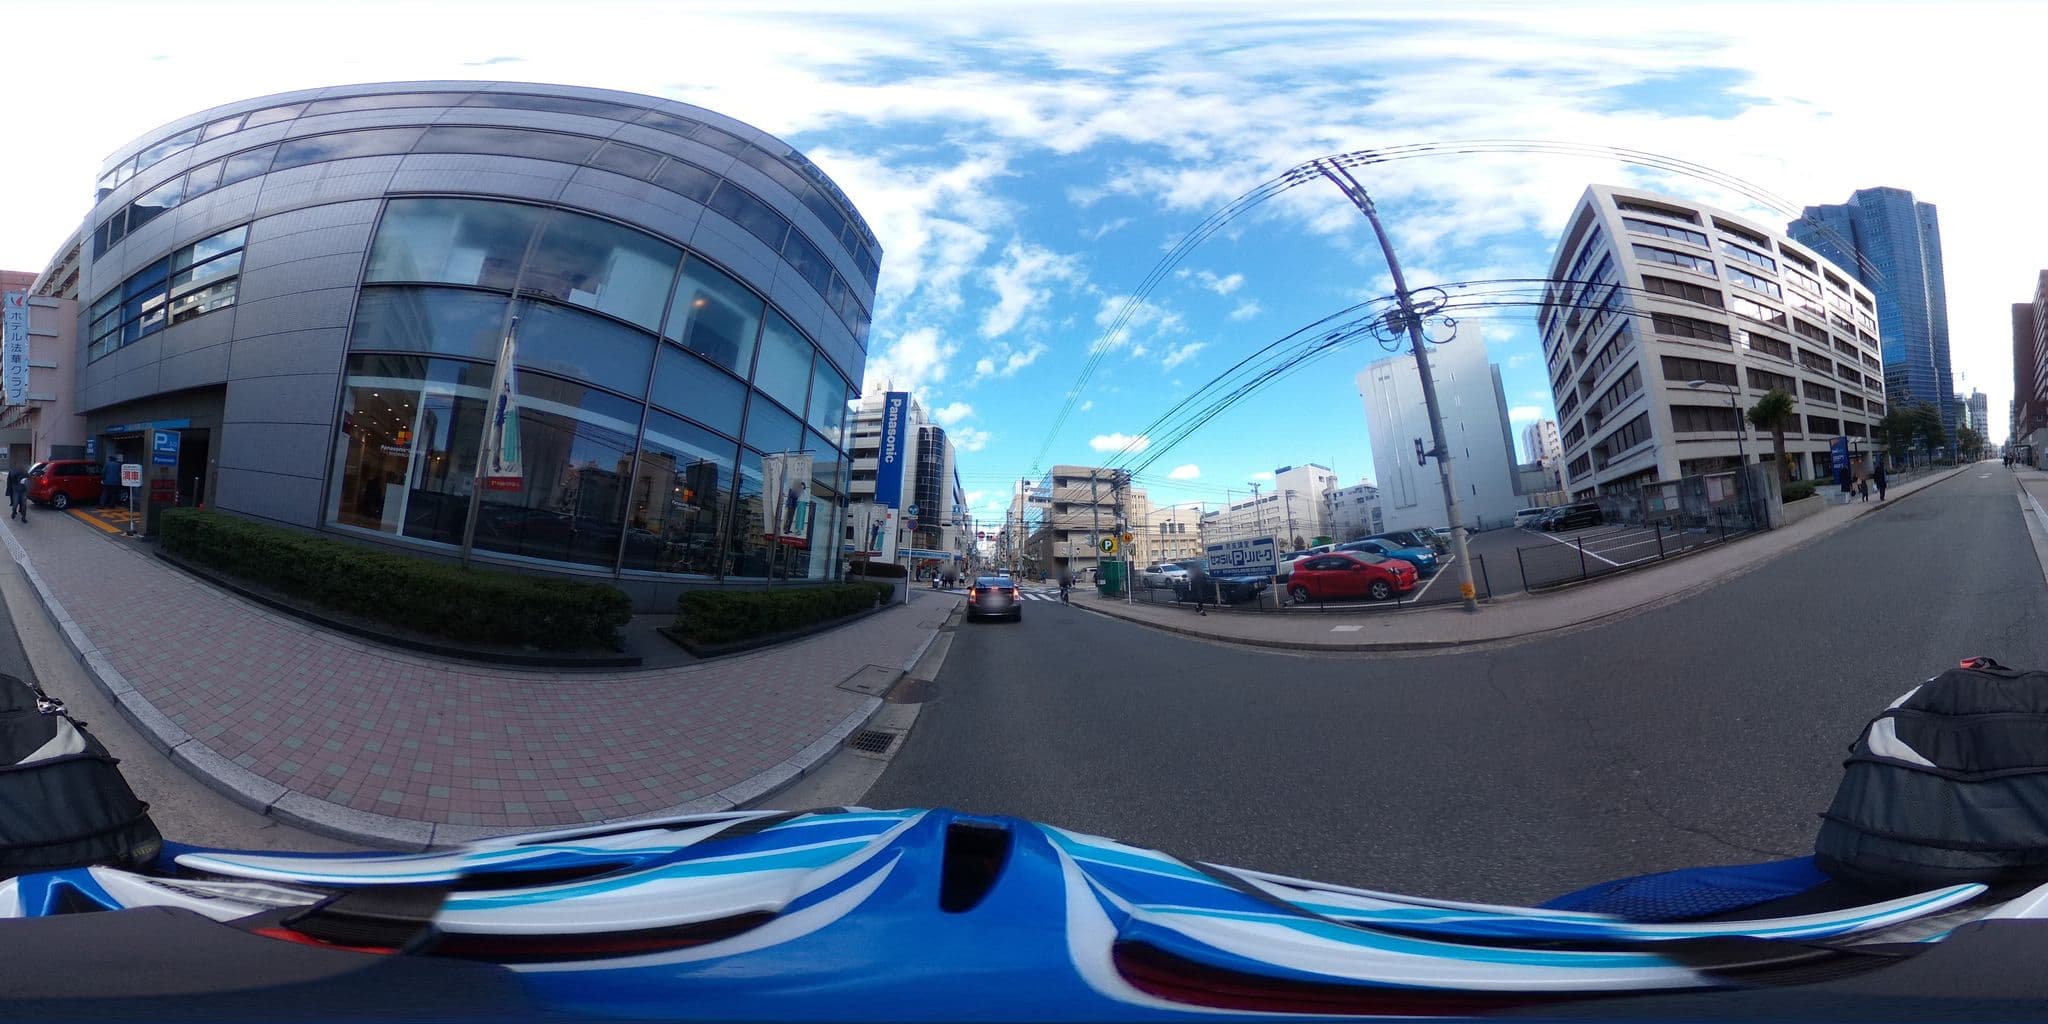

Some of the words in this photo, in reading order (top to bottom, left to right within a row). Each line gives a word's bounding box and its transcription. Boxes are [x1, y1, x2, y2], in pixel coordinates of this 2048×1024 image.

[885, 399, 902, 464] Panasonic
[154, 433, 168, 451] P
[1104, 540, 1112, 550] P
